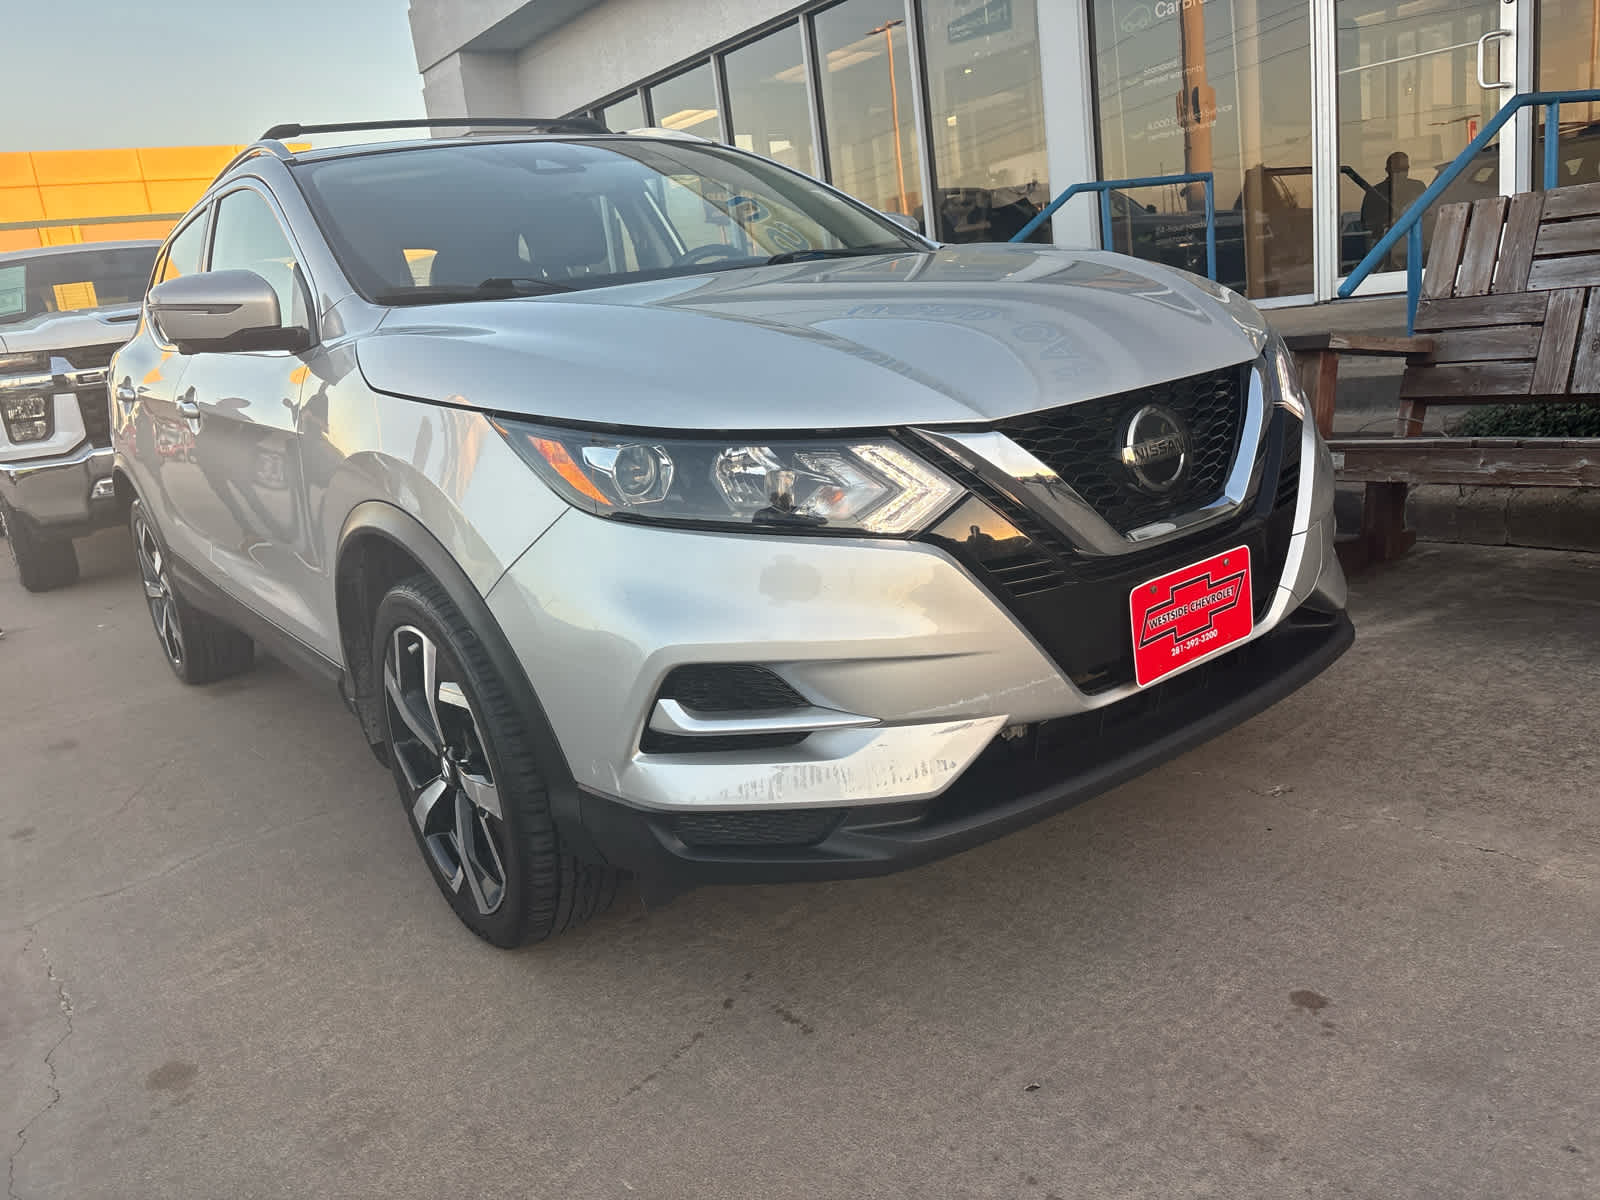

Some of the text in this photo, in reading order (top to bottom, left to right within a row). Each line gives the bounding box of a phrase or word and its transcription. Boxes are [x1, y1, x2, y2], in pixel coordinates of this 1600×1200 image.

[1134, 438, 1184, 460] NISSAN
[1147, 586, 1235, 631] WESTSIDE CHEVROLET
[1171, 629, 1218, 657] 281-392-3200
